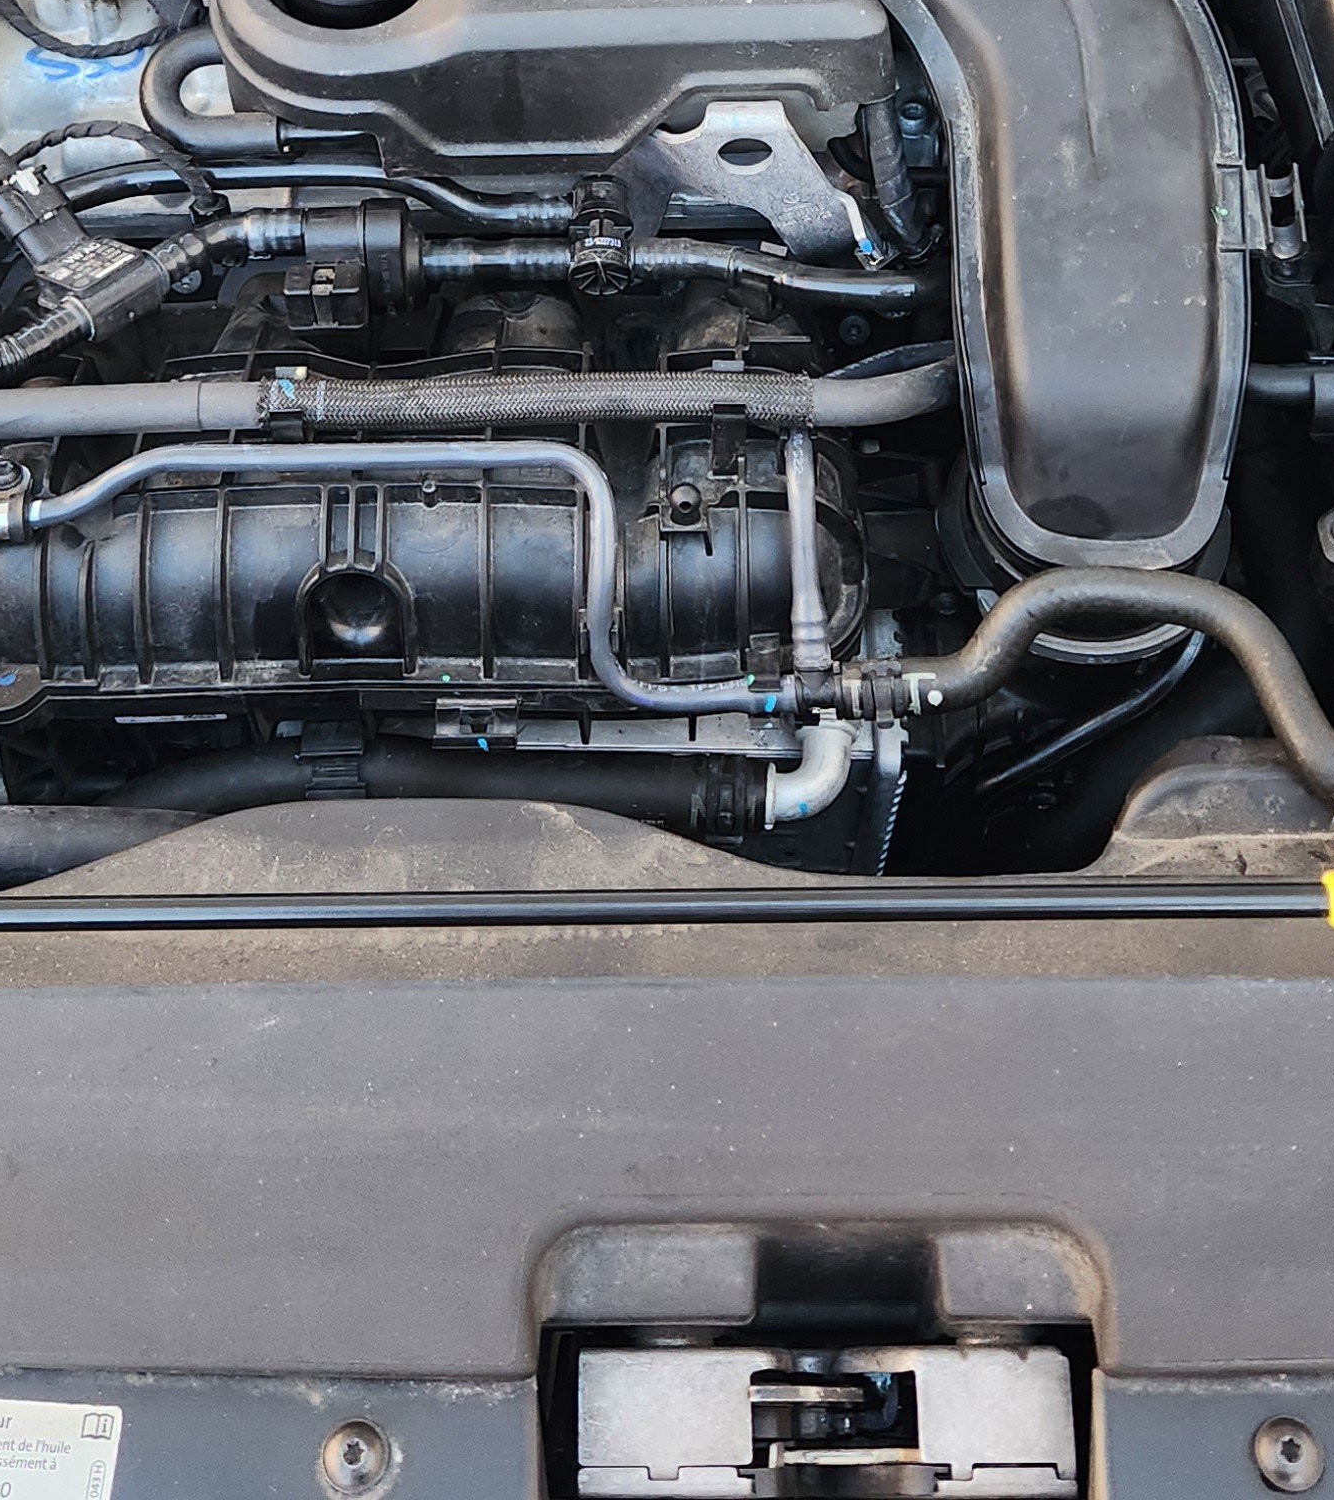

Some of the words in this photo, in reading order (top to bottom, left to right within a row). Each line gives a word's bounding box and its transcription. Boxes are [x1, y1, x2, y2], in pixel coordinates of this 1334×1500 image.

[18, 1438, 33, 1452] de
[35, 1439, 72, 1454] l'huile
[49, 1457, 57, 1470] à
